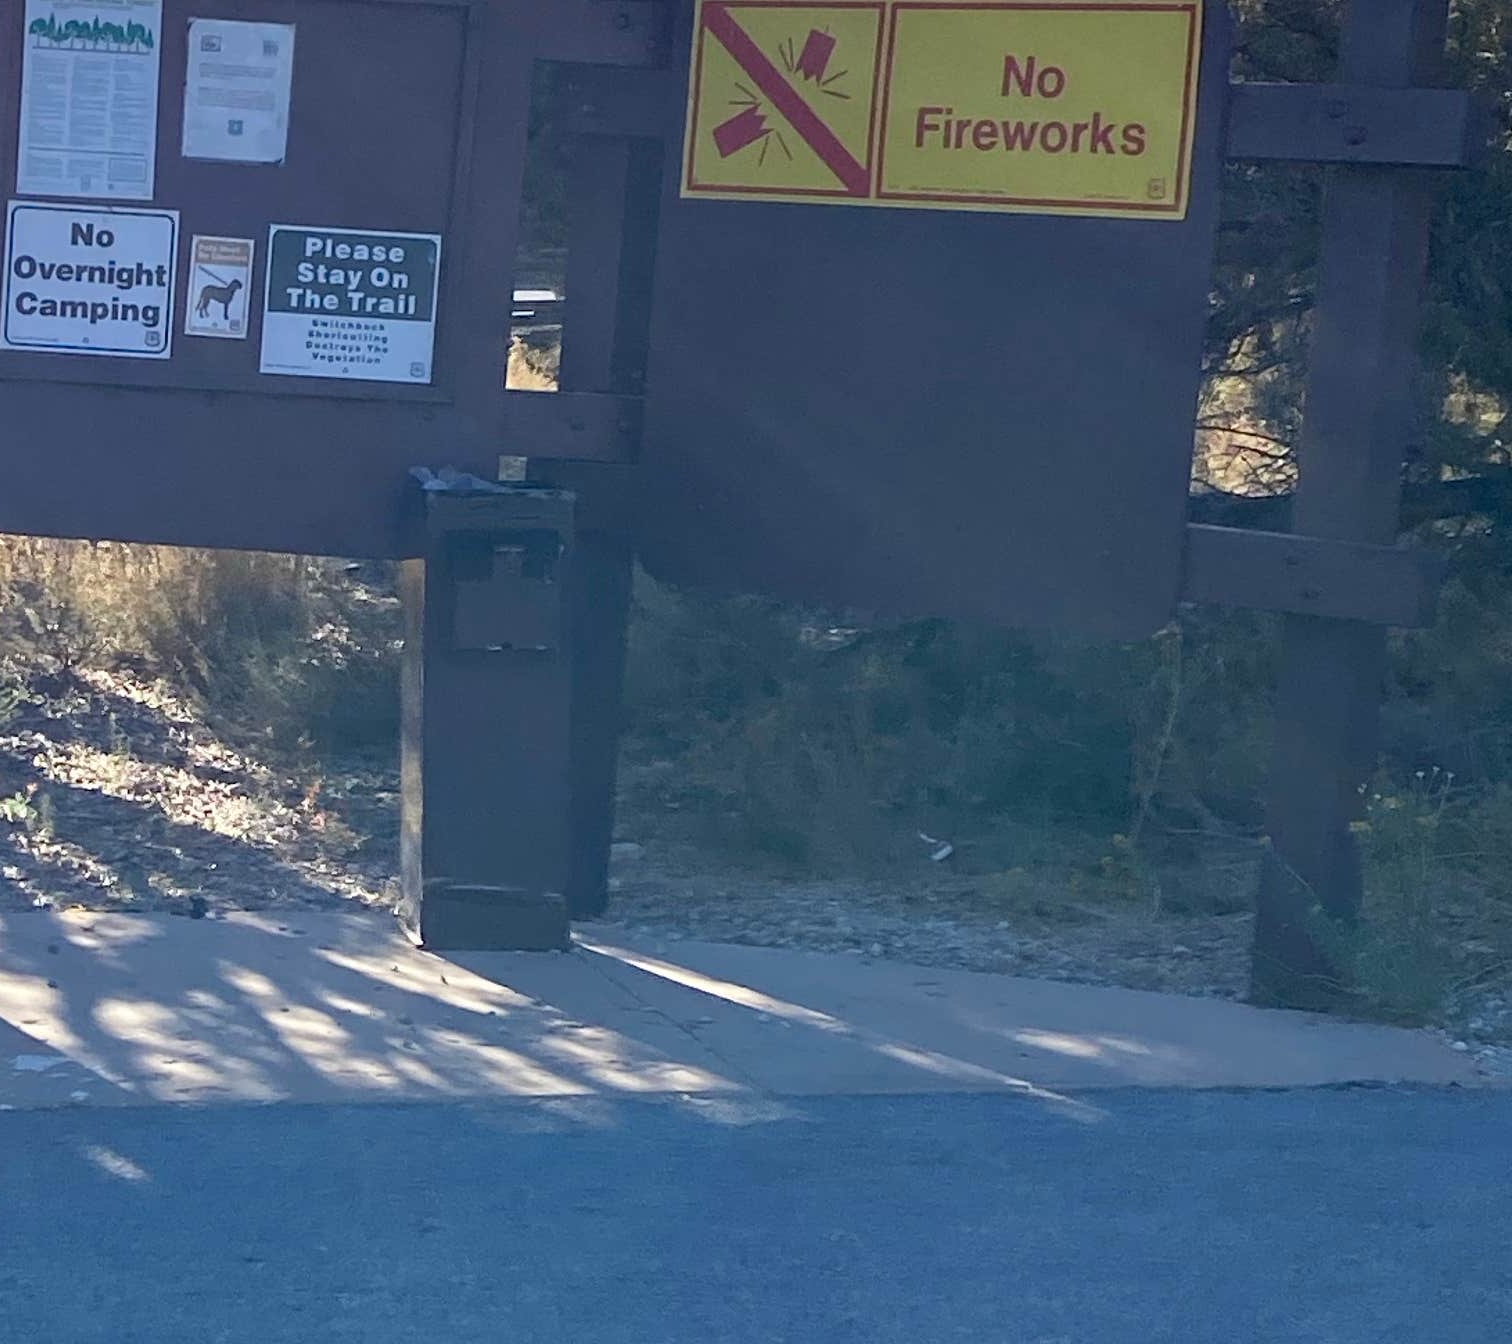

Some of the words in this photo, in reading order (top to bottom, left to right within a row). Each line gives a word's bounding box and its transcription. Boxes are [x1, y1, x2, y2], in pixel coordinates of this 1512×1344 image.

[1001, 55, 1065, 98] No
[915, 106, 1146, 156] Fireworks
[70, 222, 115, 248] No
[304, 236, 405, 263] Please
[13, 254, 167, 290] Overnight
[297, 262, 363, 290] Stay
[370, 267, 409, 289] On
[15, 291, 161, 328] Camping
[286, 287, 339, 310] The
[347, 291, 416, 315] Trail
[311, 319, 385, 331] Switchback
[311, 351, 381, 364] Vegetation
[367, 344, 388, 354] The
